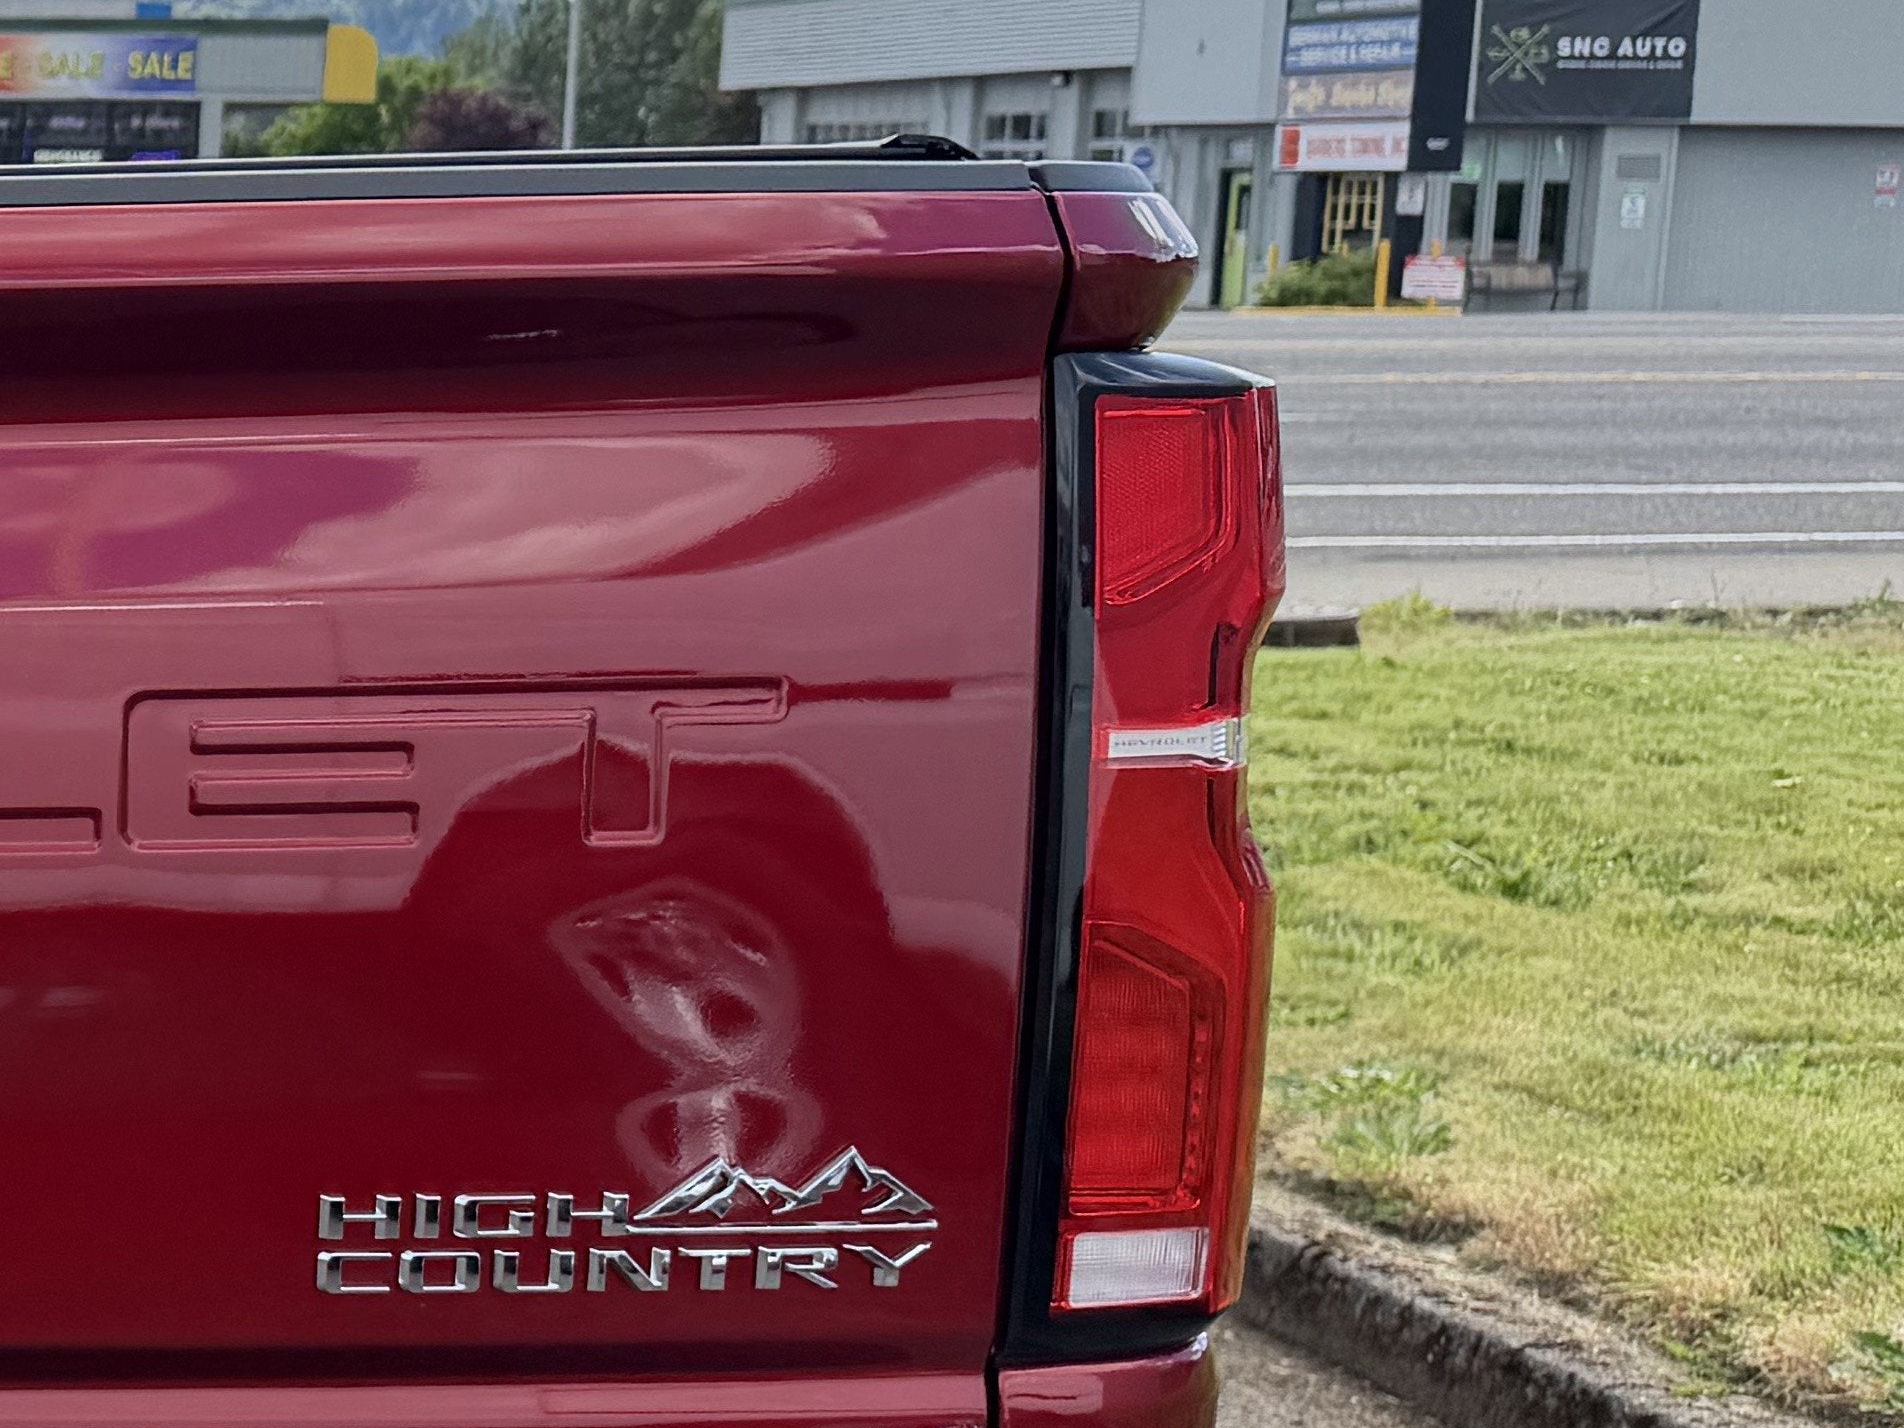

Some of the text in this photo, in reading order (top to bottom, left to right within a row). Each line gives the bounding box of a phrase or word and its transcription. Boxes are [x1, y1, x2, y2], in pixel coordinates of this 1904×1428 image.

[128, 49, 195, 80] SALE
[1616, 35, 1688, 58] AUTO
[318, 1191, 631, 1240] HIGH
[315, 1241, 935, 1294] COUNTRY
